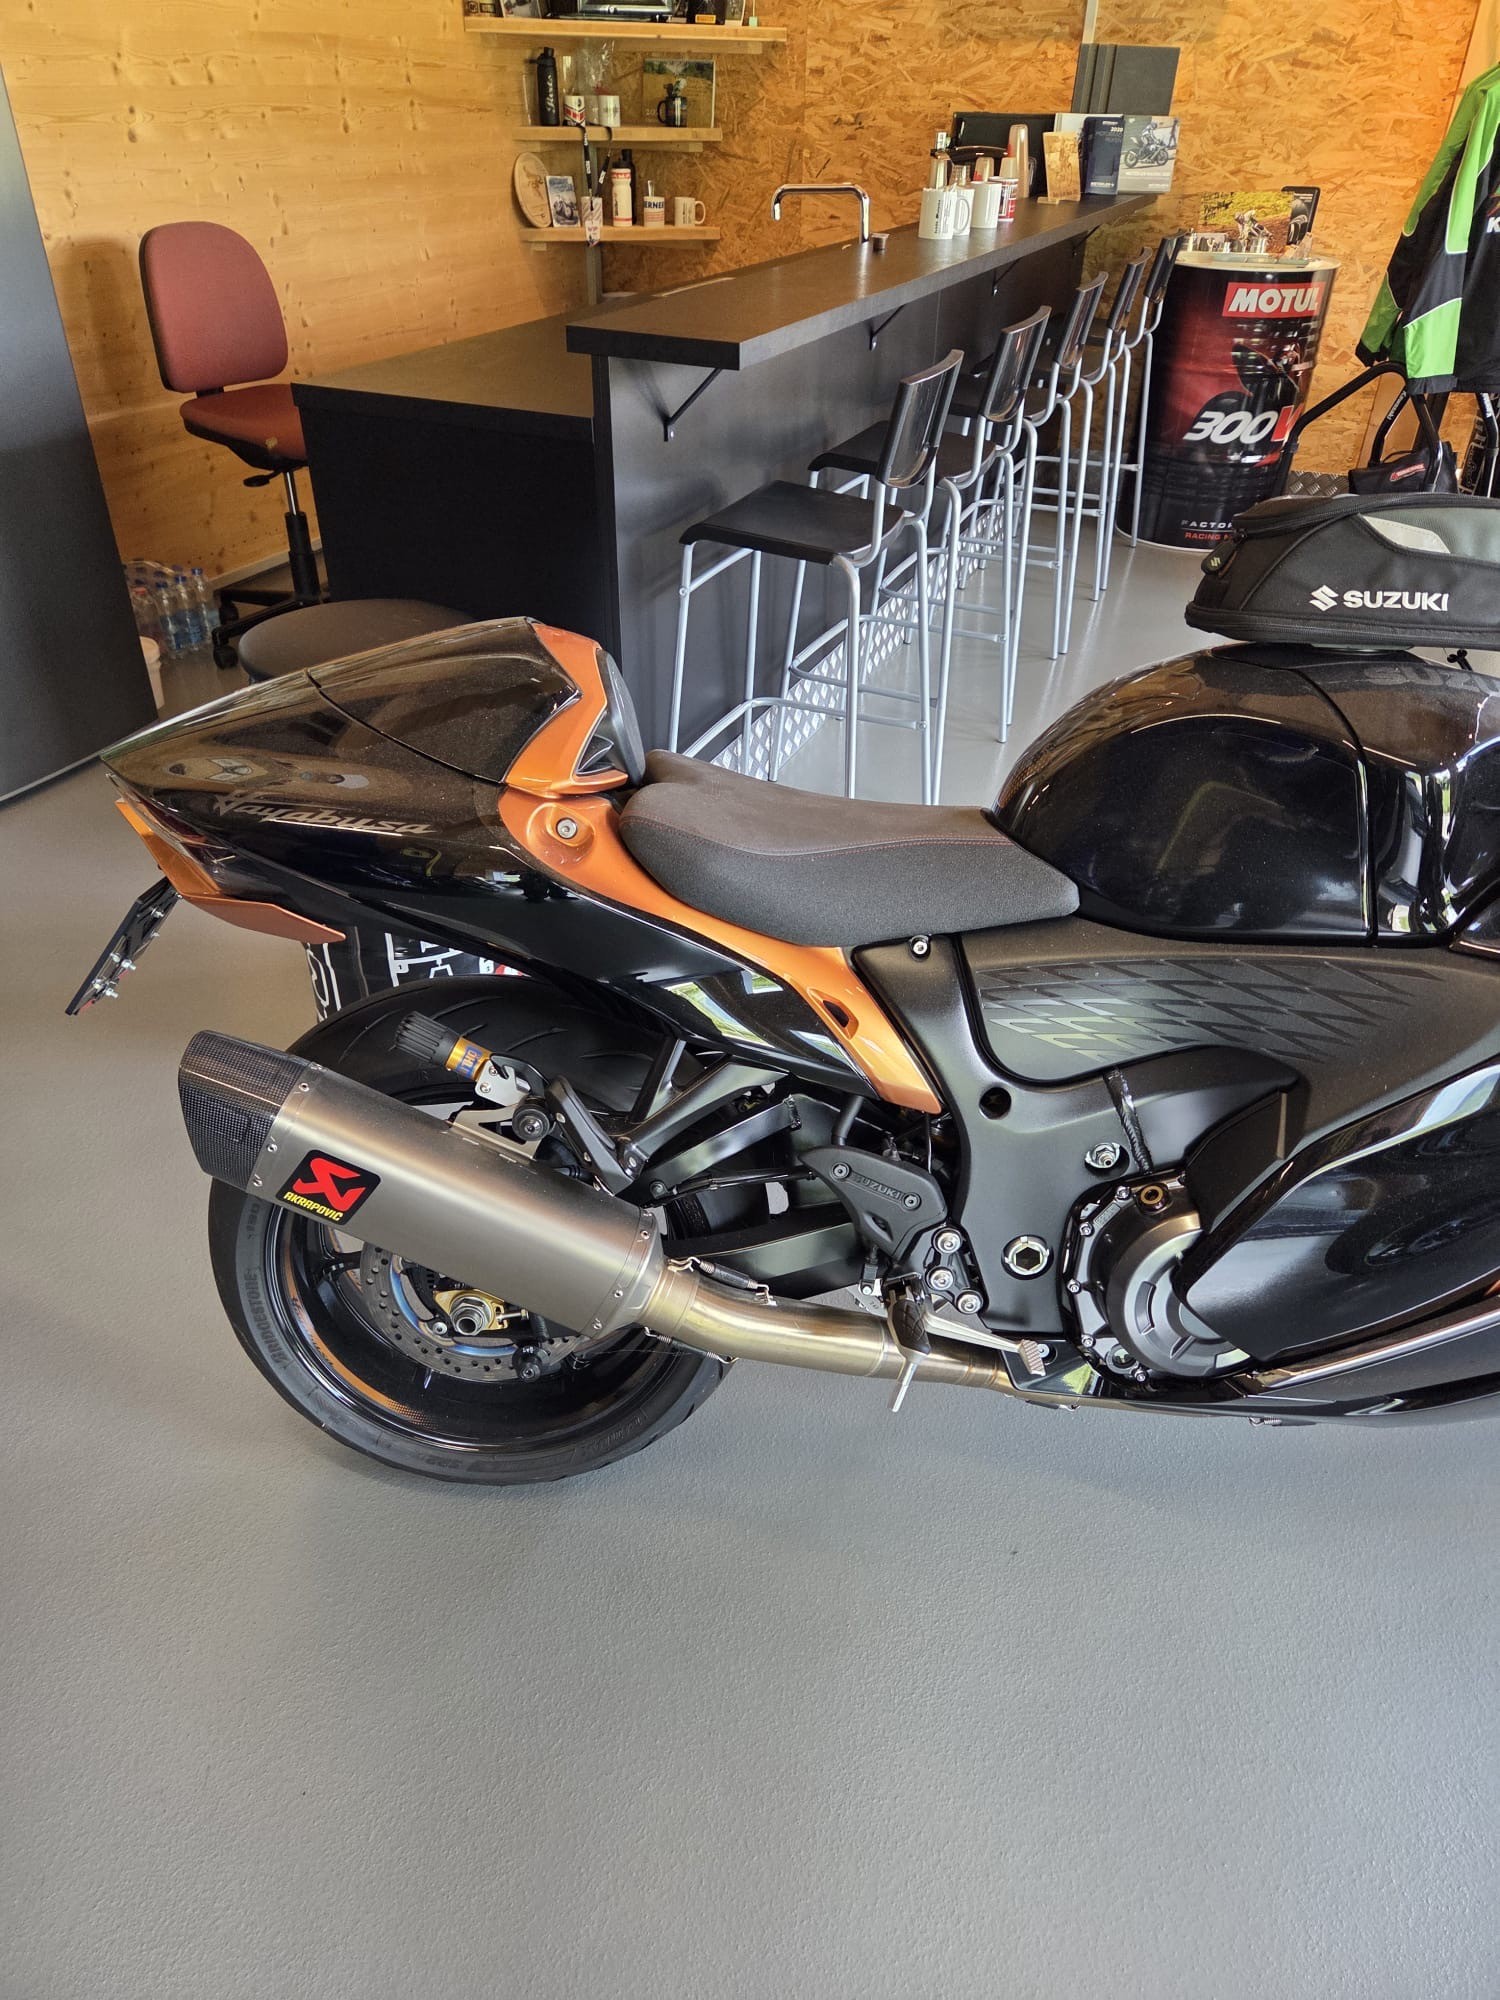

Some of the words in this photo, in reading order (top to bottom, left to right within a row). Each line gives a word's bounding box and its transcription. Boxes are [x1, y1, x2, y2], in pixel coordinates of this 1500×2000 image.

[1228, 287, 1319, 313] MOTUL
[1184, 532, 1221, 540] RACING
[1342, 590, 1449, 612] SUZUKI
[213, 789, 438, 834] Hayabusa
[852, 1175, 902, 1200] SUZUKI
[283, 1191, 344, 1221] AKRAPOVIC
